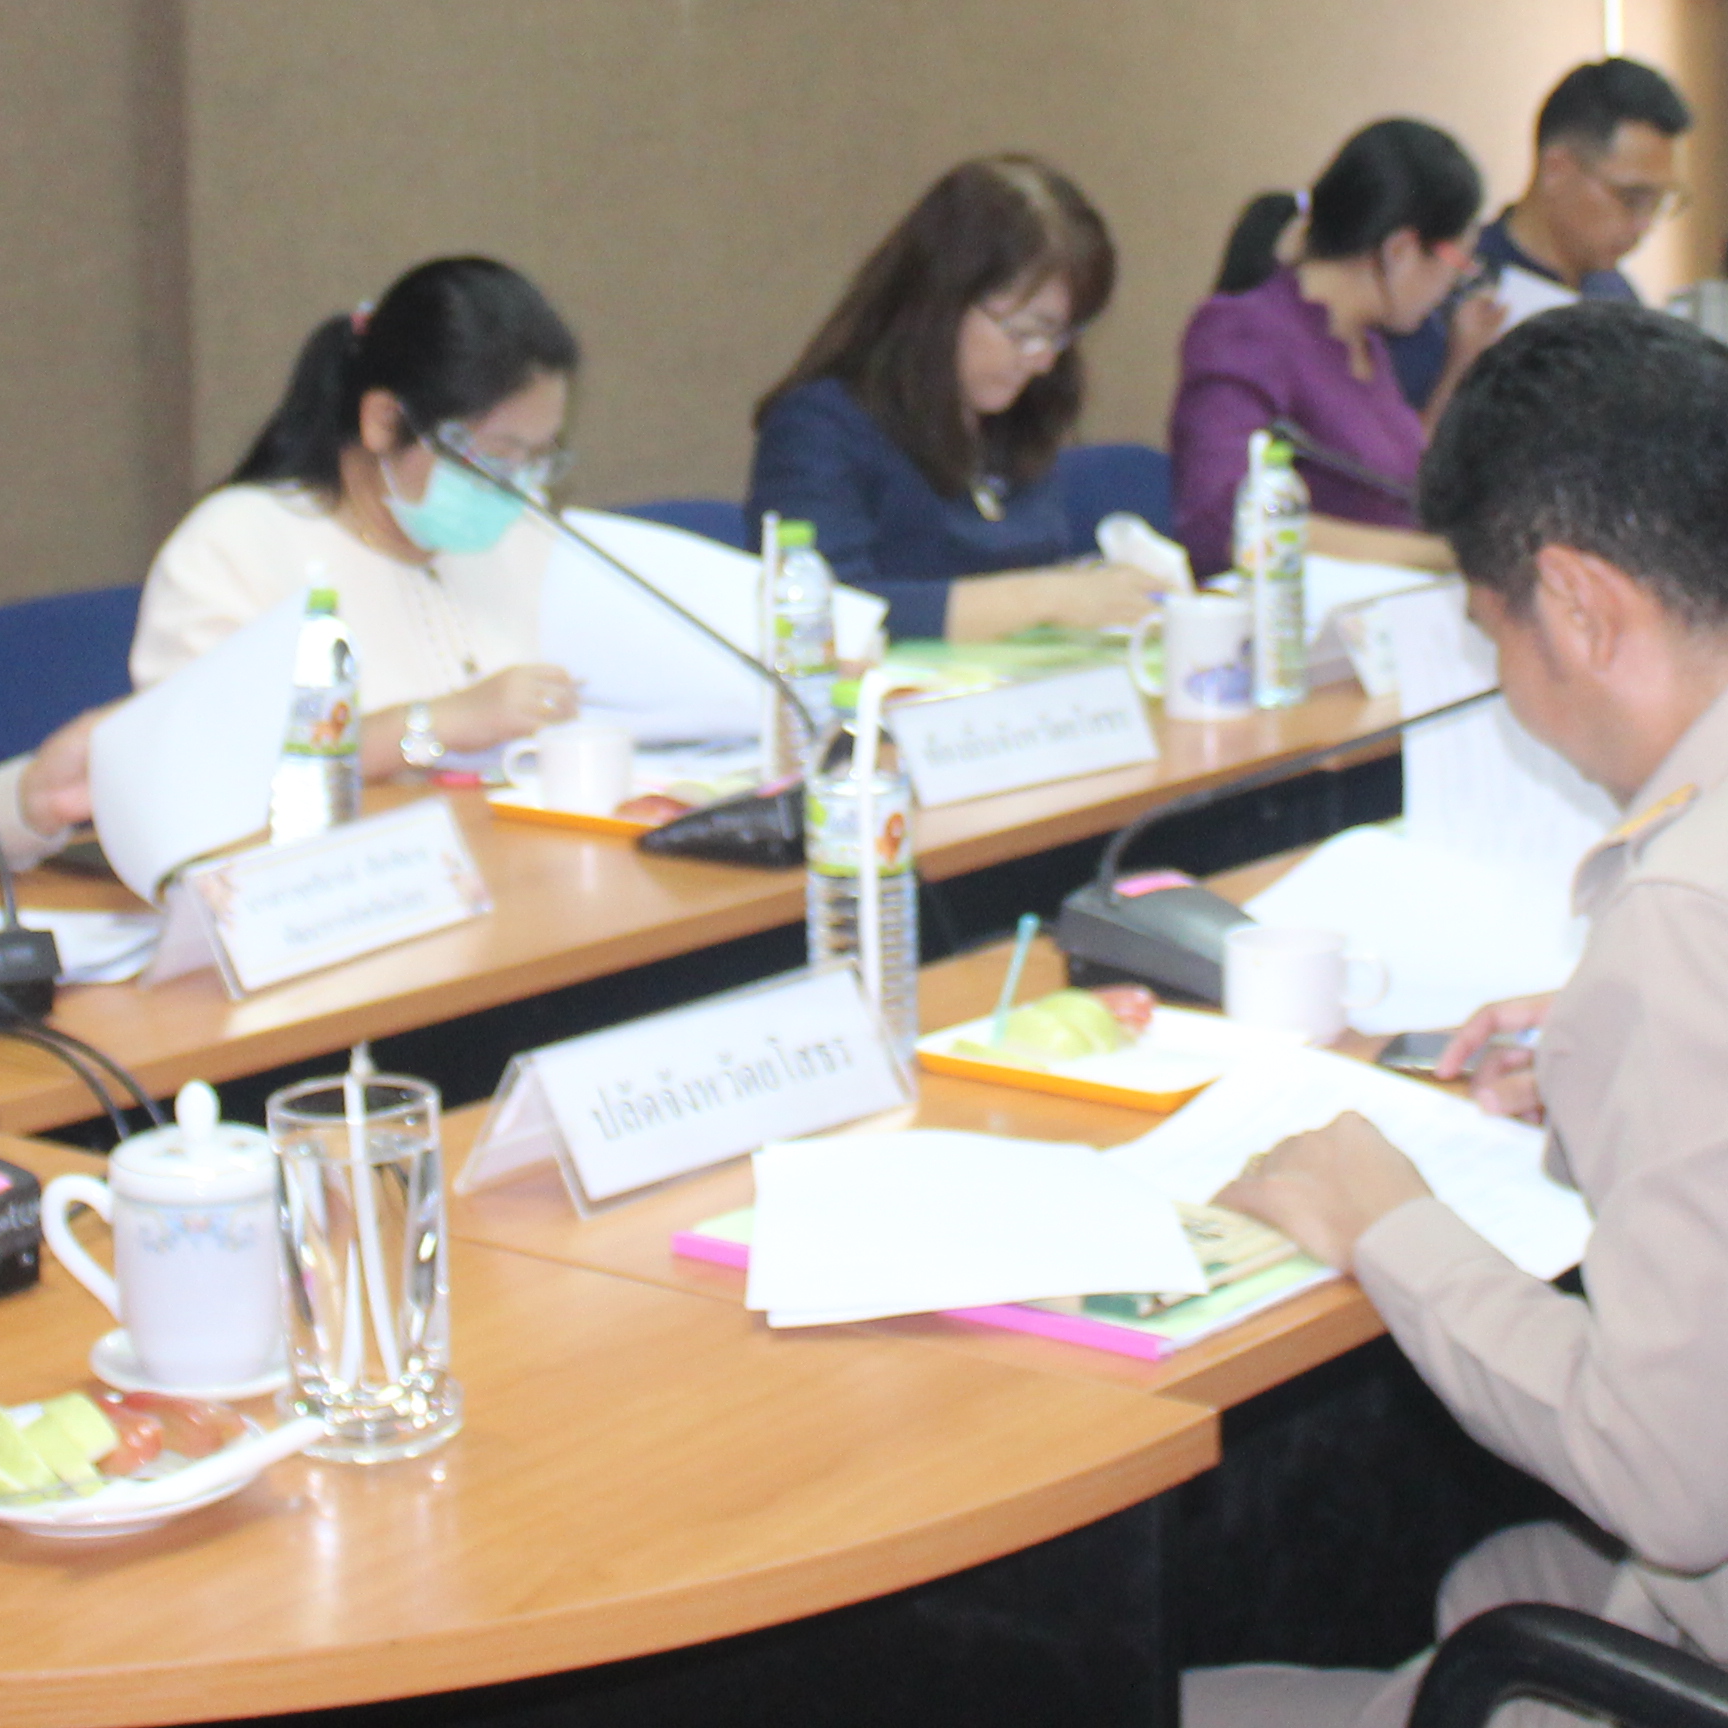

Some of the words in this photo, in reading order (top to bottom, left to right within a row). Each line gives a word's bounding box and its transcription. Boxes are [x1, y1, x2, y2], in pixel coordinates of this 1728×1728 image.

[590, 1034, 855, 1142] ปลัดจังหวัดยโสธร
